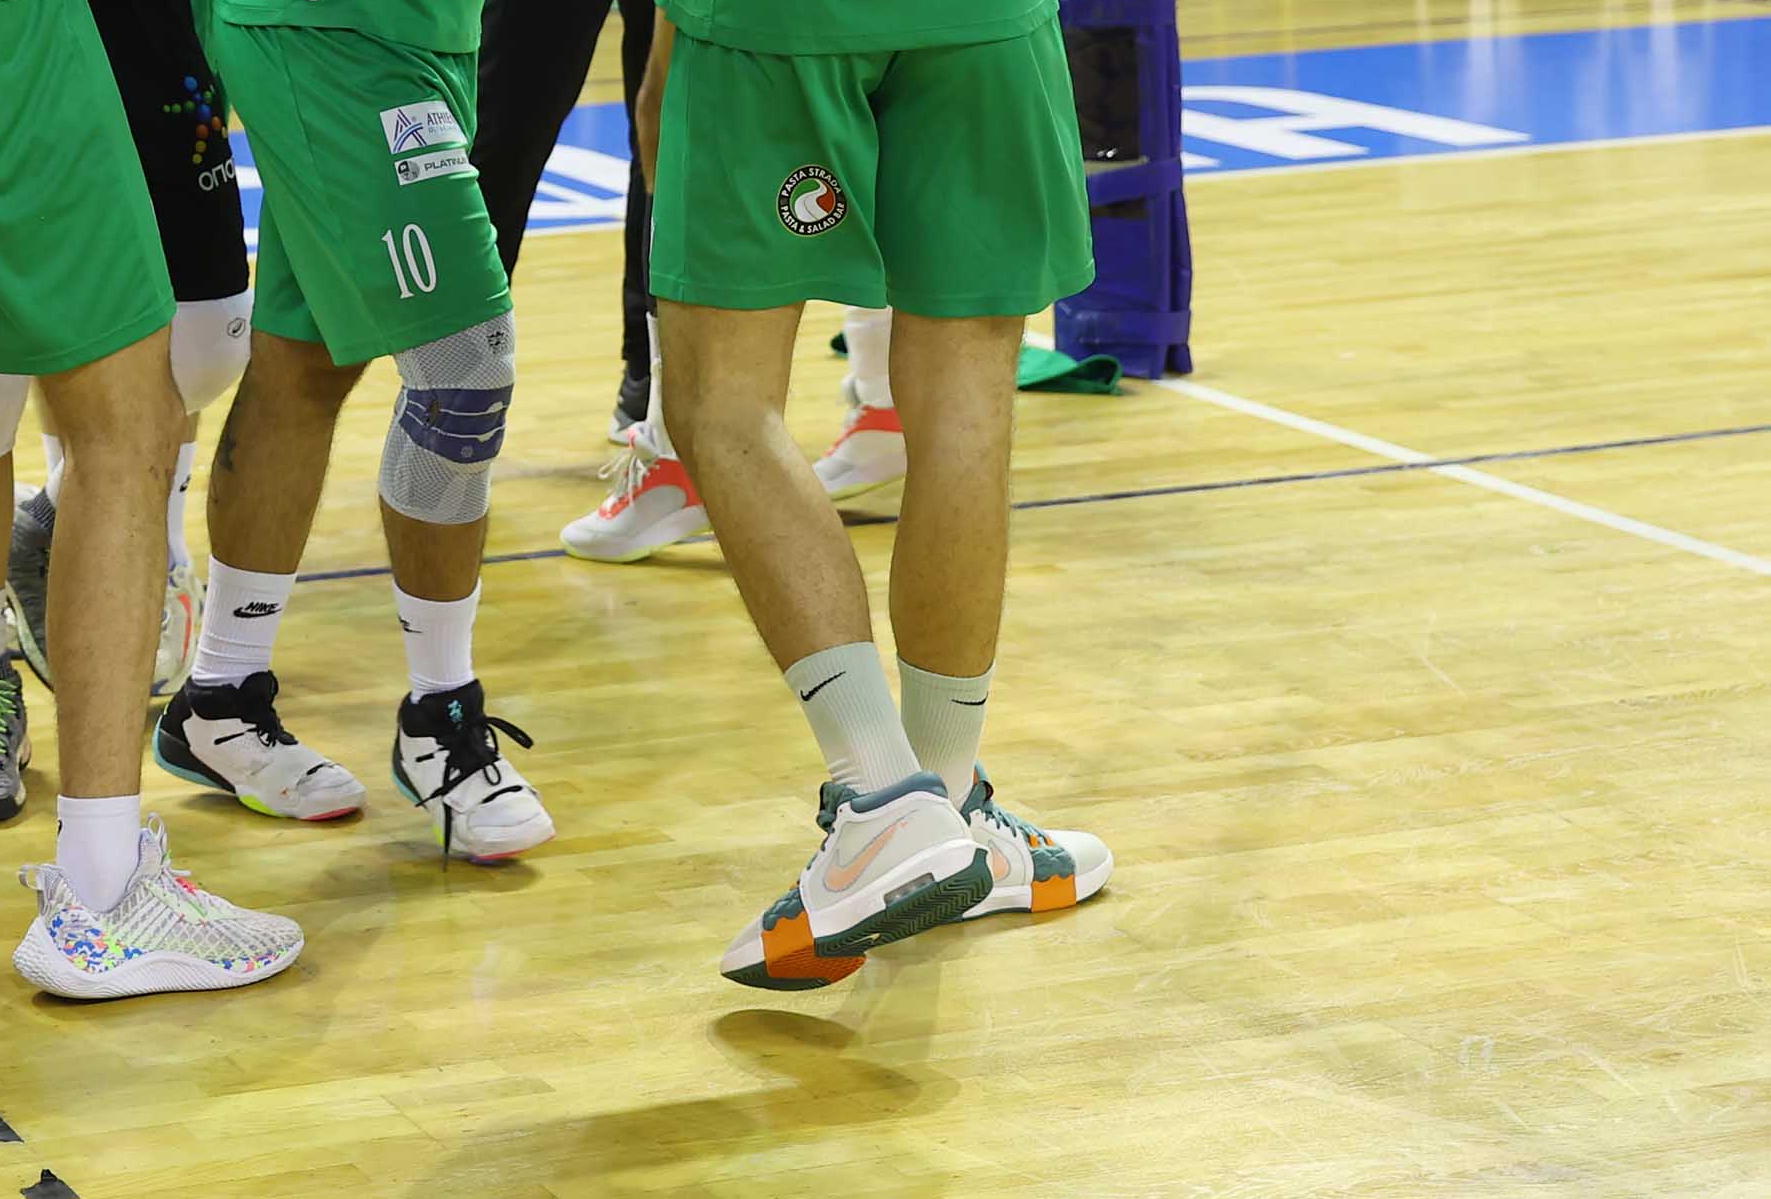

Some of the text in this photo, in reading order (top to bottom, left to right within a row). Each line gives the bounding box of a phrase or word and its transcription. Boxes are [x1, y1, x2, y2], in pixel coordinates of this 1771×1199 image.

[781, 167, 842, 197] PASTA STRADA
[780, 202, 845, 233] PASTA & SALAD BAR
[381, 223, 437, 299] 10
[244, 601, 279, 613] NIKE
